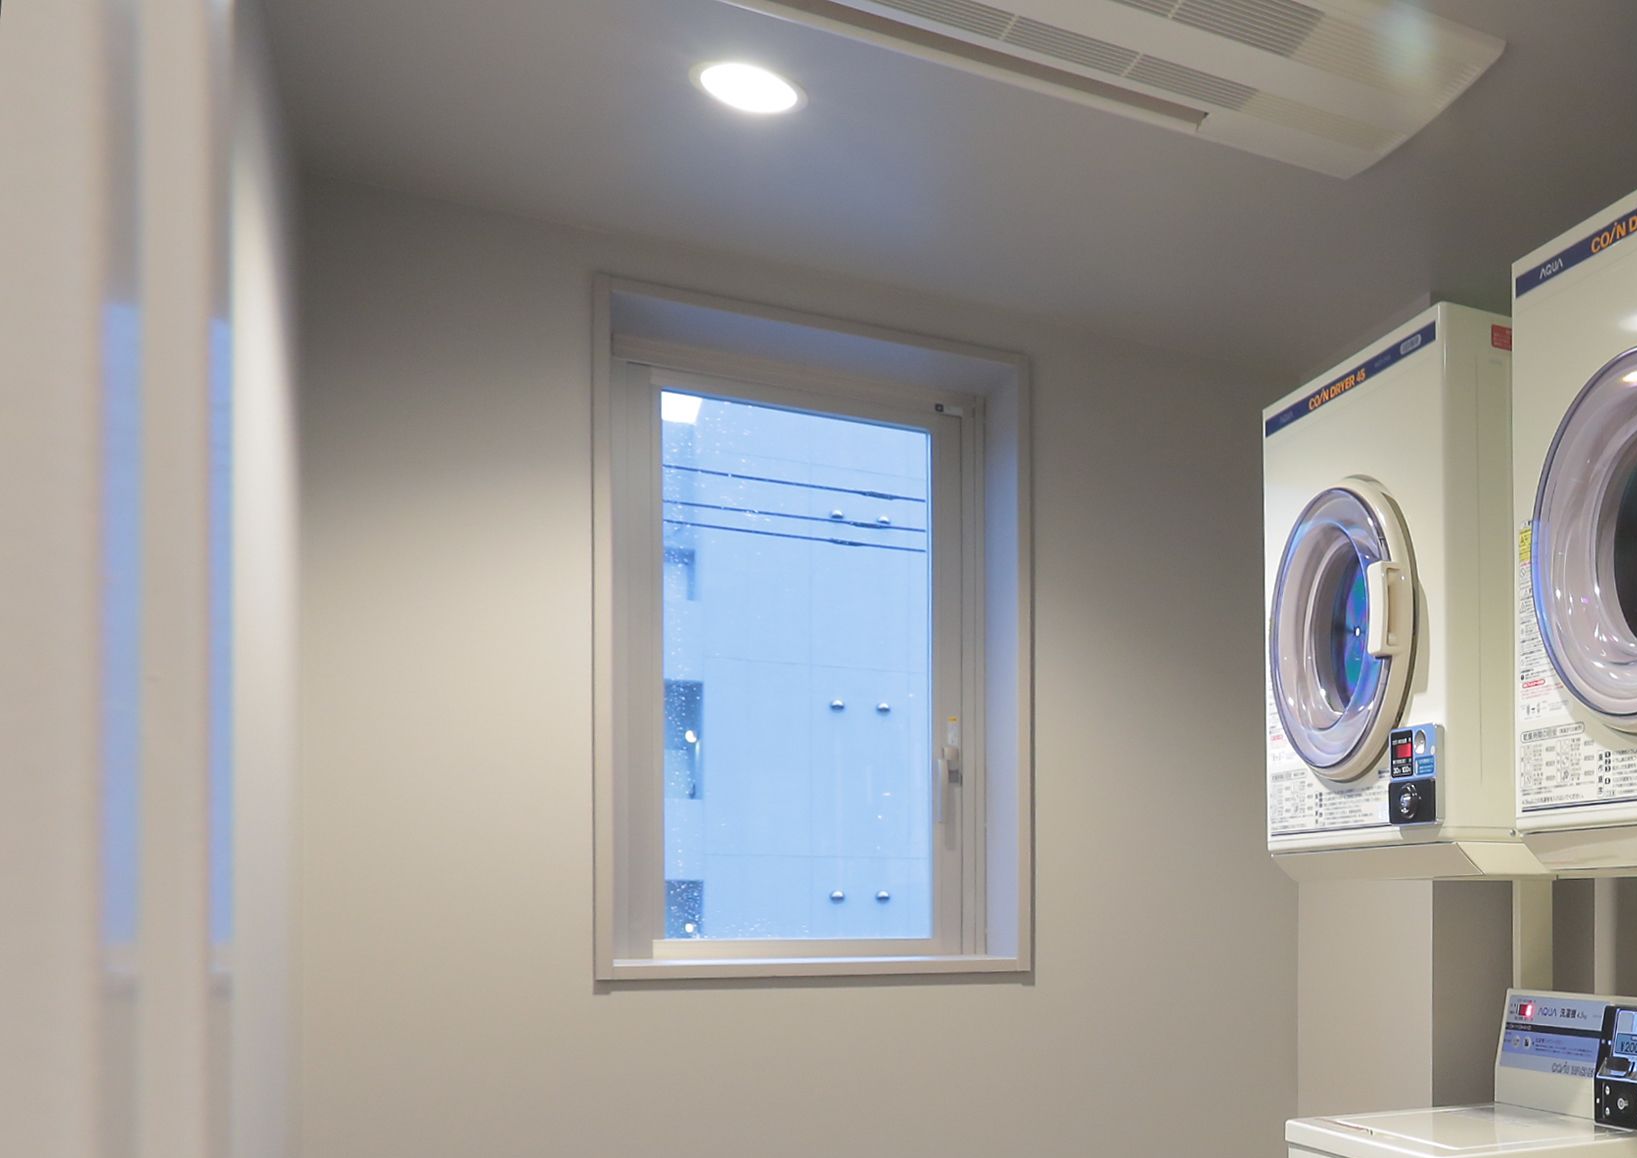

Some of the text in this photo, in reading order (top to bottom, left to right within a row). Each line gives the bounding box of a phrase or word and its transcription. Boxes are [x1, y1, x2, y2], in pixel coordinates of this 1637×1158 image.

[1539, 257, 1564, 280] AQUA
[1590, 220, 1627, 254] COIN
[1329, 376, 1355, 399] DRYER
